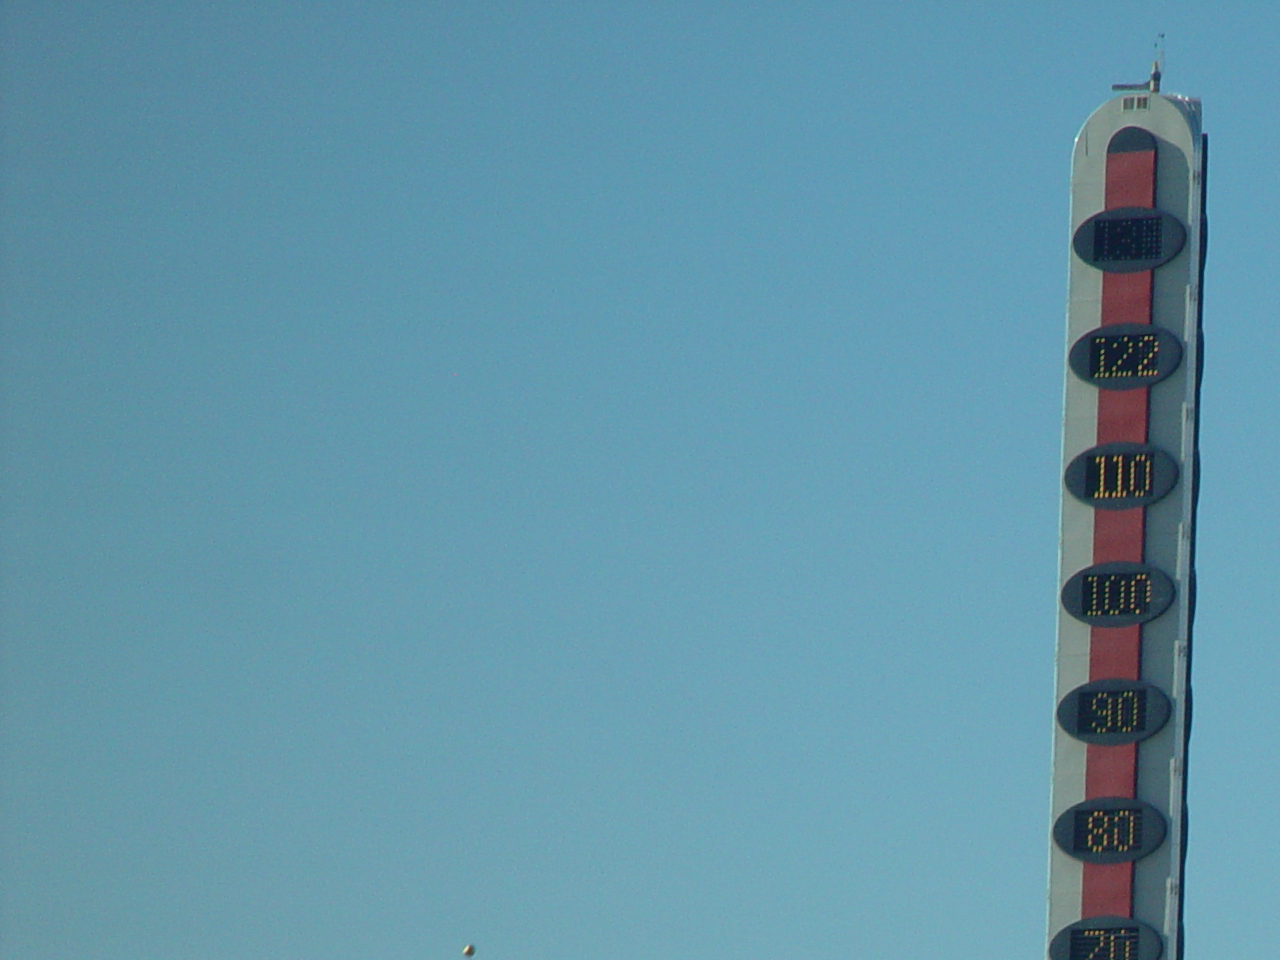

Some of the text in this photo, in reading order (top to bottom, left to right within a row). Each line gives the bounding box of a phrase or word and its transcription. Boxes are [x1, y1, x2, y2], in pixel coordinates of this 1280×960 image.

[1094, 335, 1159, 378] 122
[1094, 454, 1151, 498] 110
[1087, 573, 1151, 616] 100
[1091, 691, 1138, 733] 90
[1087, 810, 1134, 852] 80
